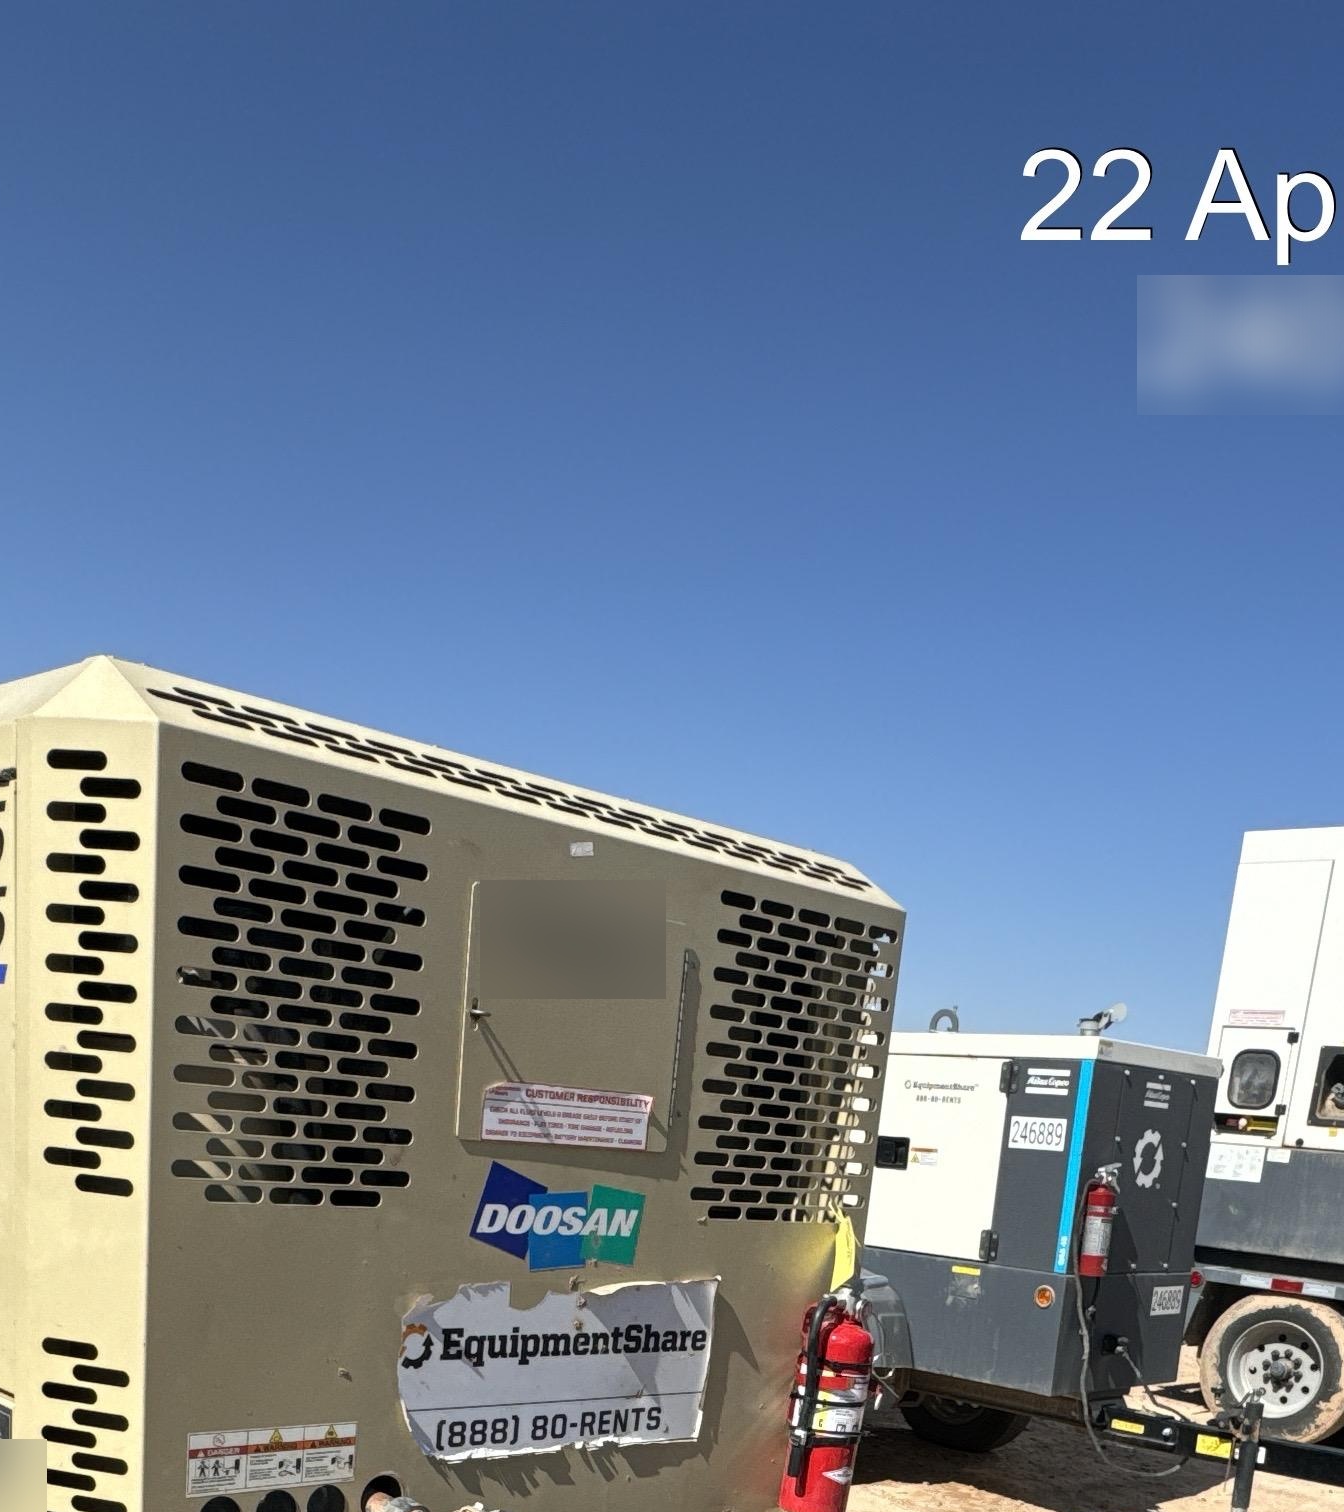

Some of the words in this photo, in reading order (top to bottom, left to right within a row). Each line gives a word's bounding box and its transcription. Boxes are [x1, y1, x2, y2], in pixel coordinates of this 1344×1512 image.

[525, 1088, 575, 1102] CUSTOMER
[576, 1093, 650, 1109] RESPONSIBILITY
[1011, 1120, 1063, 1146] 246889
[476, 1203, 639, 1237] DOOSAN
[440, 1324, 707, 1367] EquipmentShare
[436, 1415, 520, 1451] (888)
[531, 1407, 662, 1441] 80-RENTS
